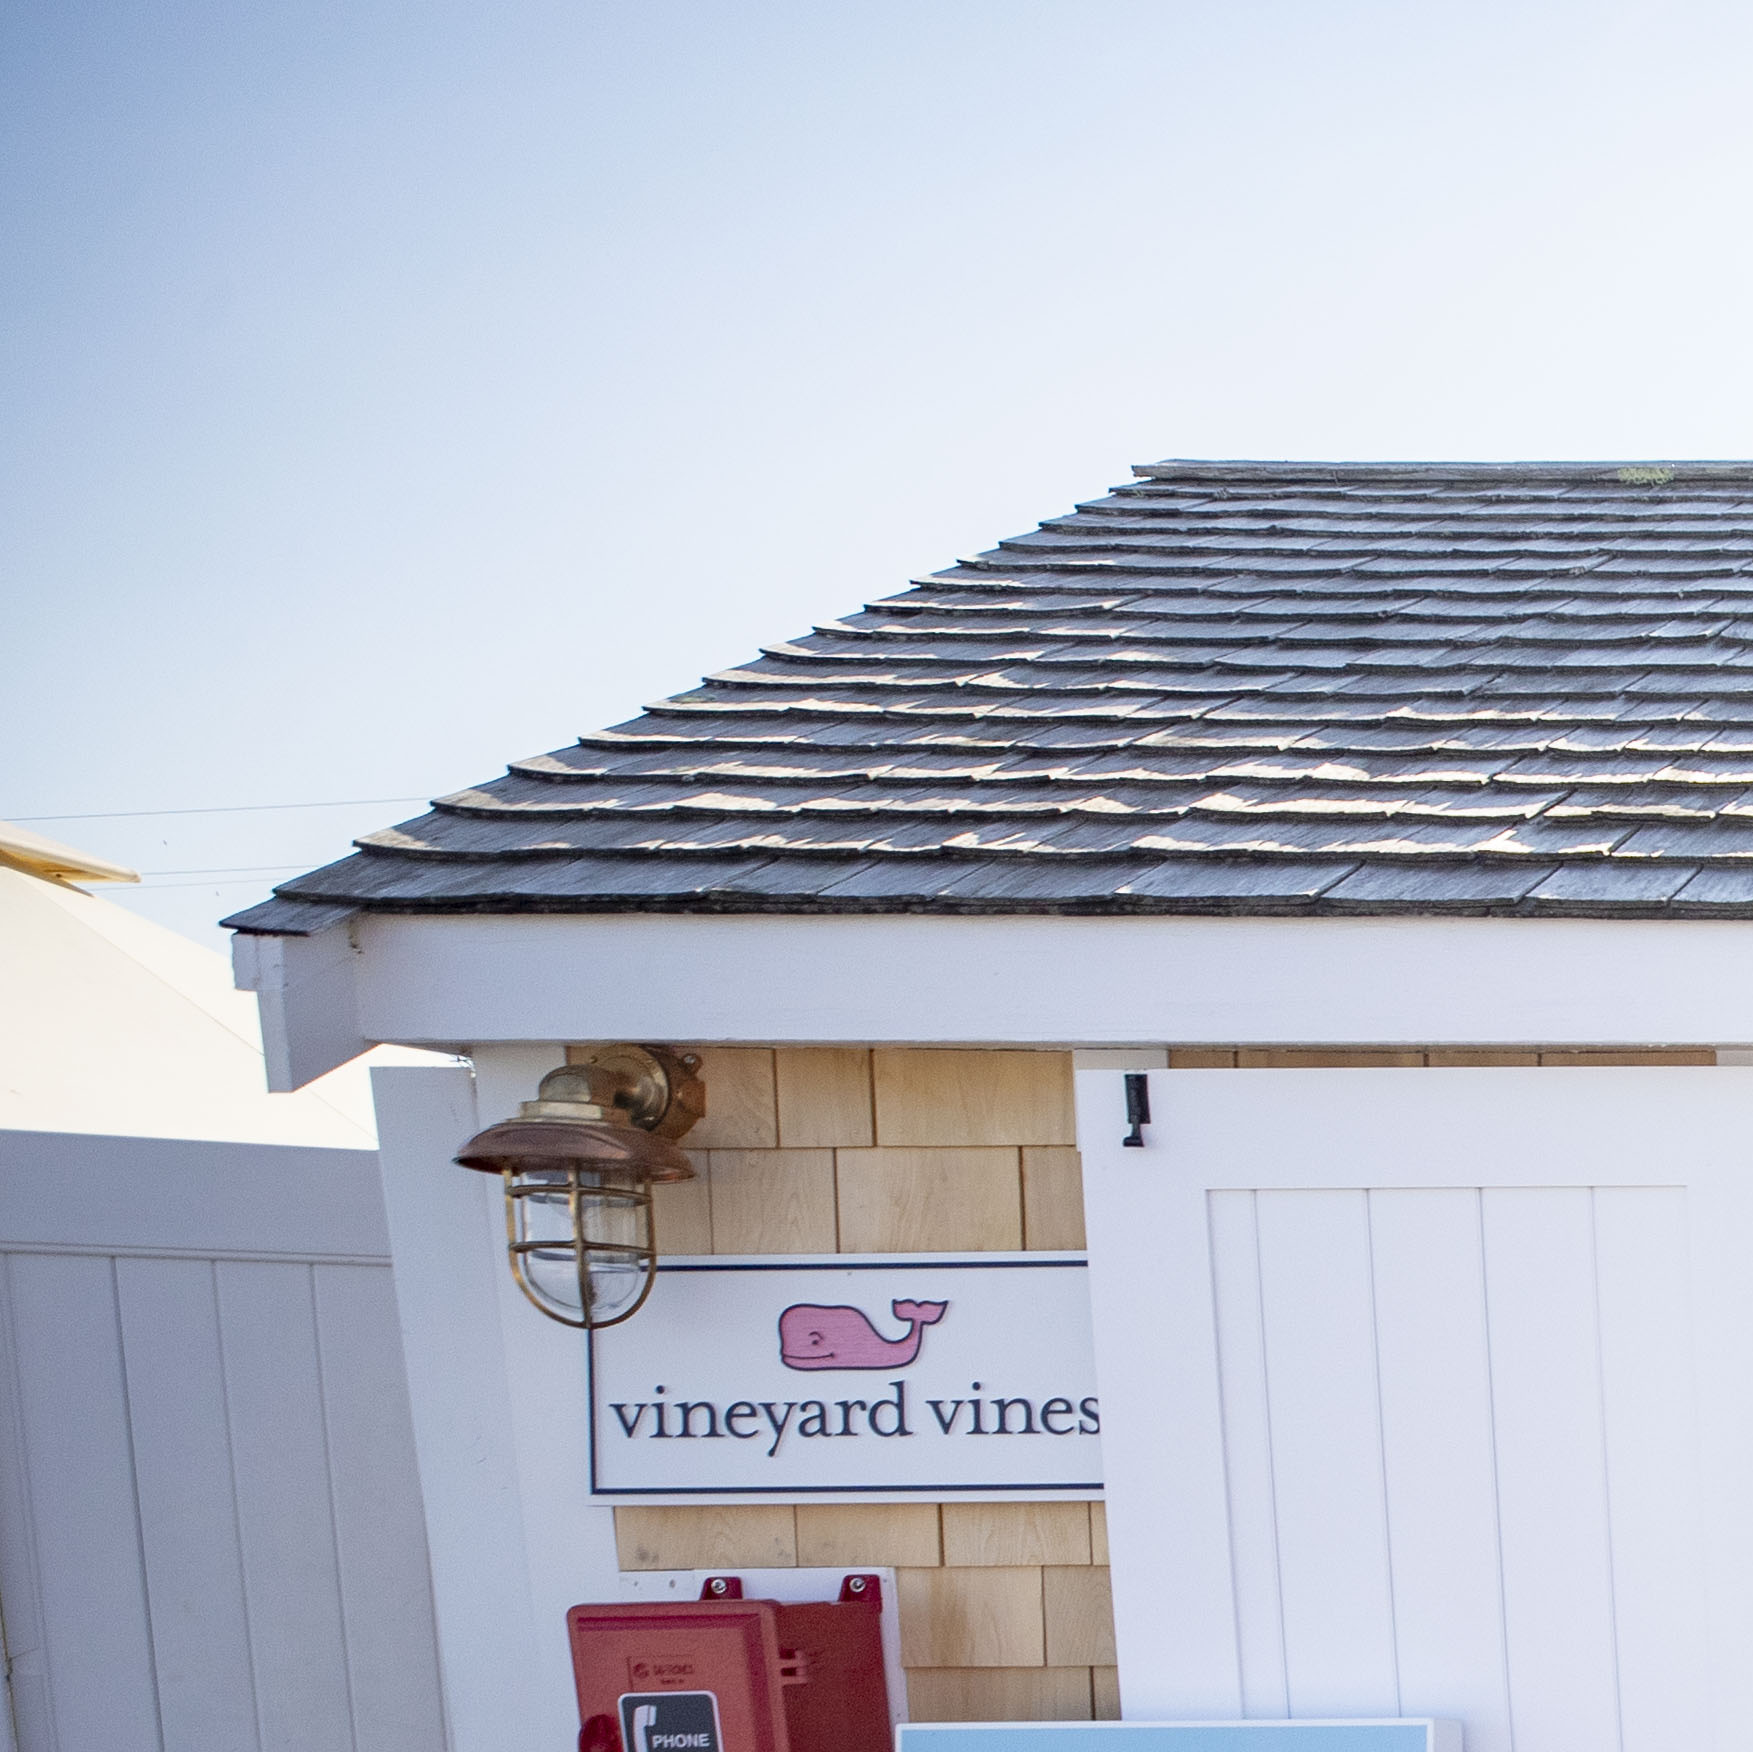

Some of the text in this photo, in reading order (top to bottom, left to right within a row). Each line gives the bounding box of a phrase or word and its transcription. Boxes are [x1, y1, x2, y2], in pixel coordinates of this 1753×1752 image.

[610, 1380, 1101, 1458] vineyard vines
[652, 1733, 711, 1749] PHONE
